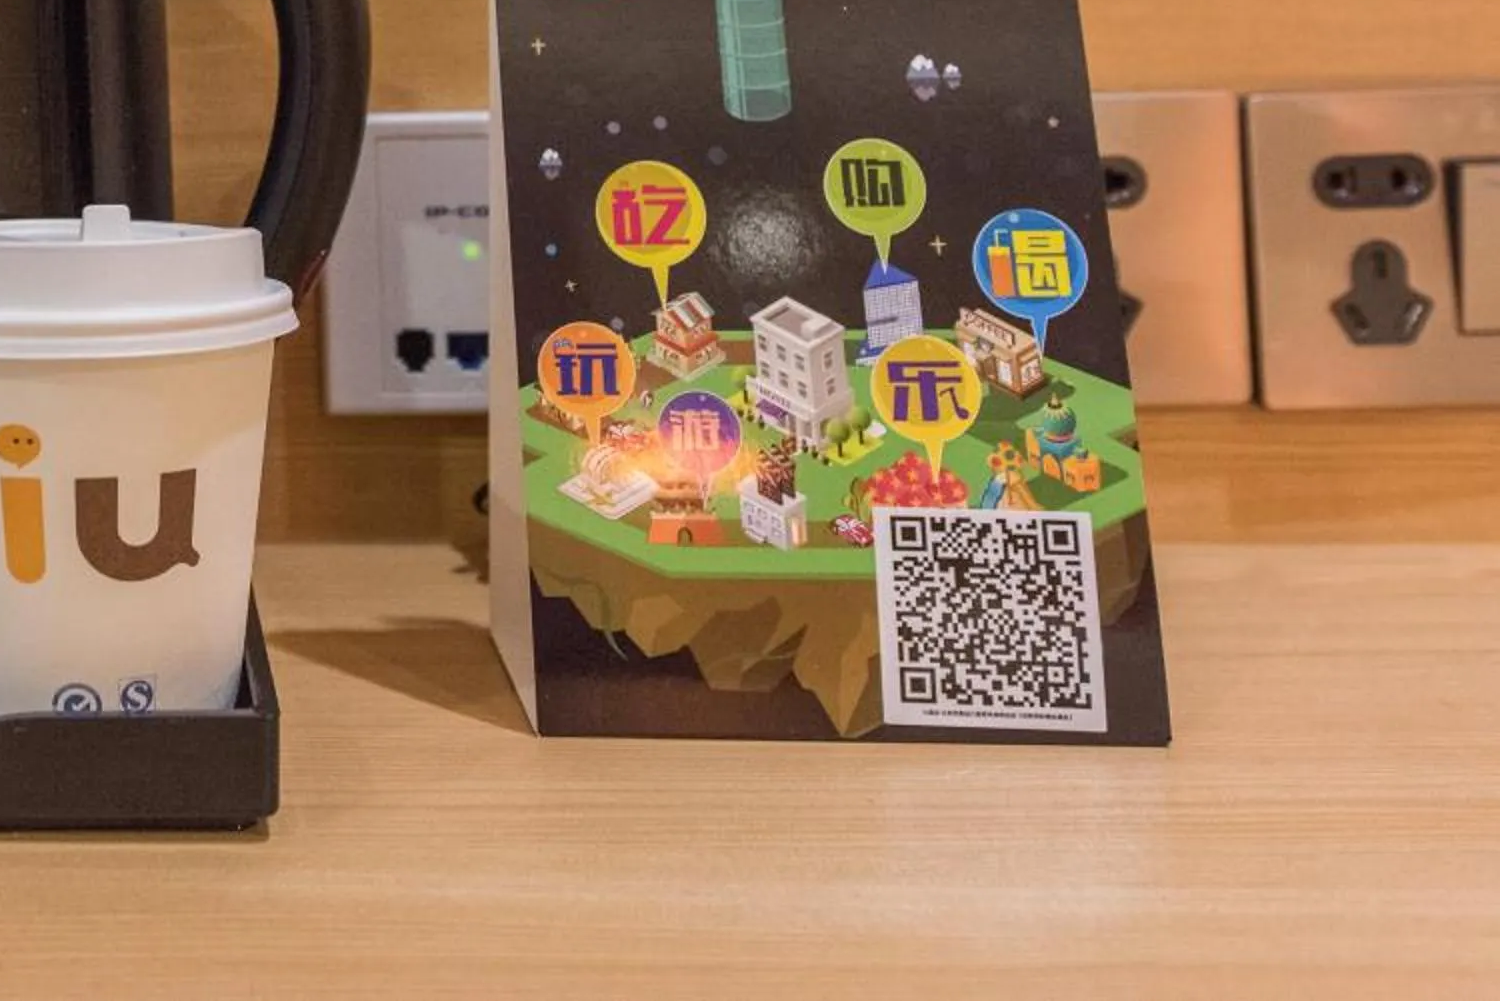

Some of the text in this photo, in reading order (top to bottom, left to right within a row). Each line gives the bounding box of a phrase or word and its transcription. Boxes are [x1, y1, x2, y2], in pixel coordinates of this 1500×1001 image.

[840, 157, 906, 210] 购
[611, 183, 690, 247] 吃
[552, 338, 621, 397] 玩
[888, 359, 971, 423] 乐
[668, 407, 725, 454] 游
